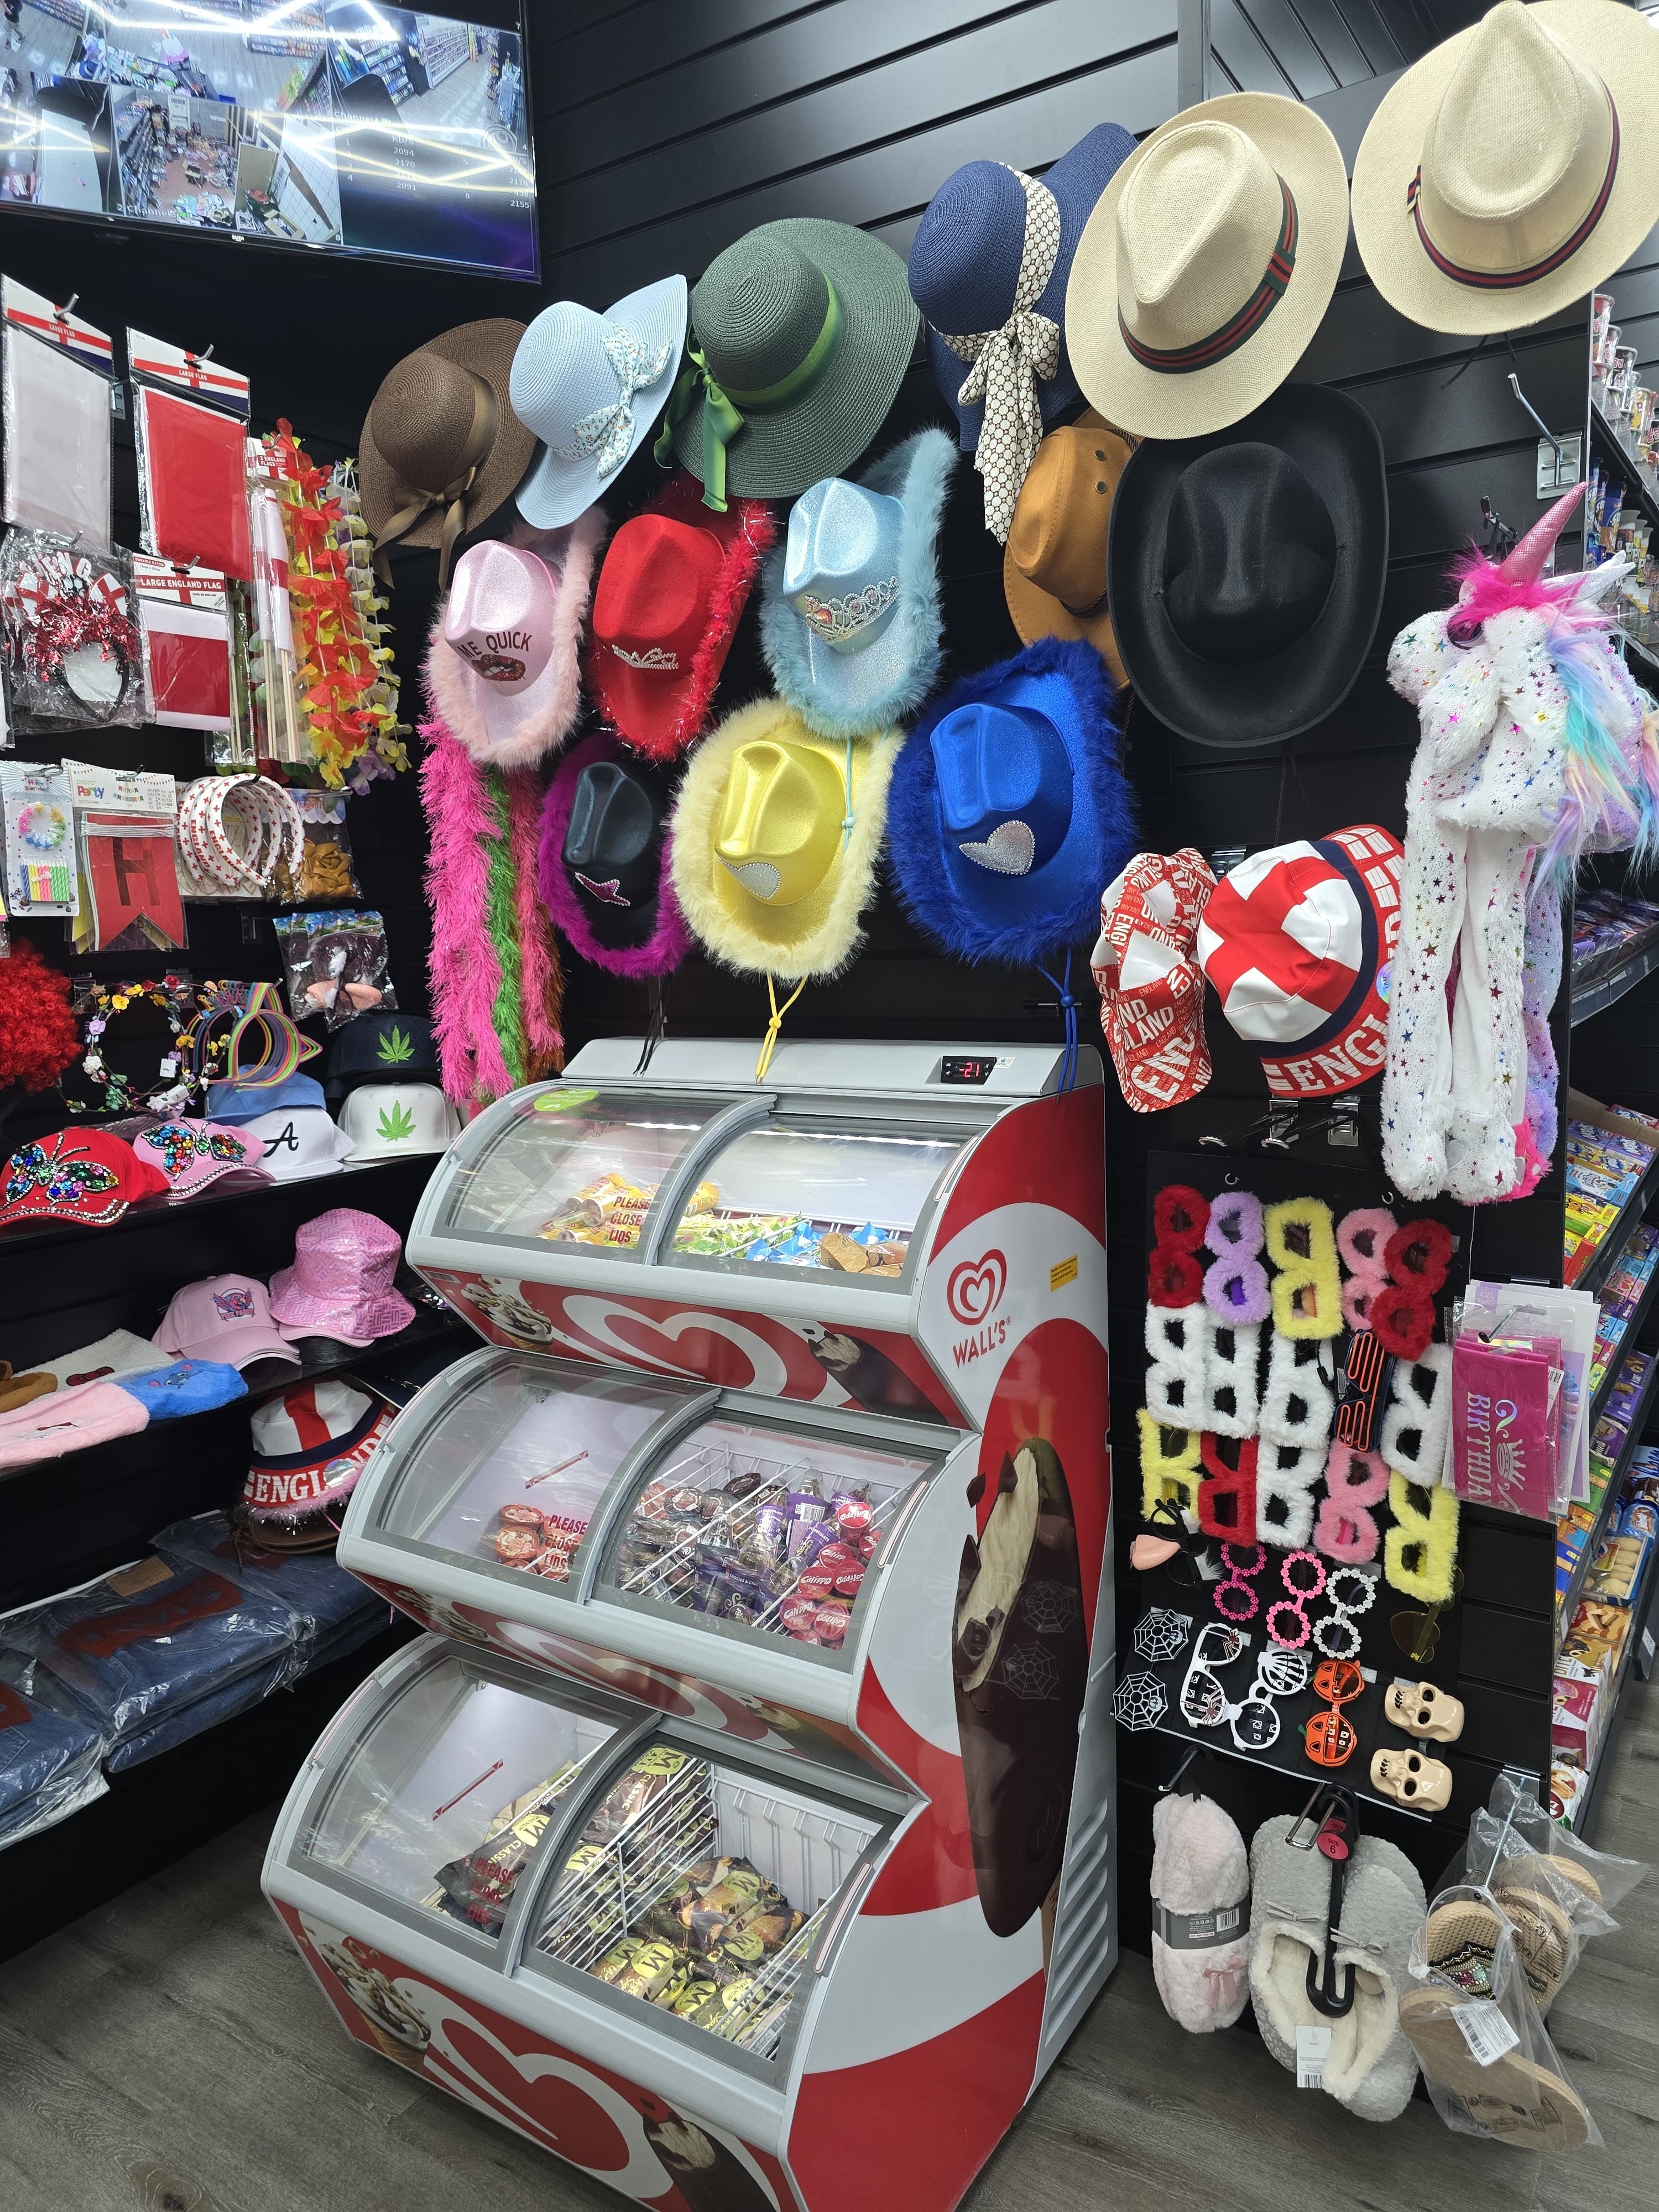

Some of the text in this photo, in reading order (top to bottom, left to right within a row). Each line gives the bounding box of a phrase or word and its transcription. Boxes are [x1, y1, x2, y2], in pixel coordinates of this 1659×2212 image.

[393, 148, 415, 156] 2094
[396, 182, 418, 191] 2091
[509, 200, 530, 208] 2155
[64, 328, 76, 338] FLAG
[178, 368, 208, 382] LARGE FLAG
[140, 578, 222, 589] LARGE ENGLAND FLAG
[456, 631, 533, 659] ME QUICK
[76, 785, 105, 800] Party
[190, 819, 211, 869] ENGLAND
[1139, 979, 1164, 997] ENGLAND
[1155, 1026, 1177, 1048] ENGLAND
[958, 1062, 980, 1078] -21
[263, 1121, 299, 1159] A
[613, 1196, 652, 1210] PLEASE
[610, 1213, 643, 1227] CLOSE
[608, 1229, 632, 1243] LIDS
[952, 1321, 1006, 1370] WALL'S
[548, 1514, 588, 1535] PLEASE
[545, 1533, 579, 1553] CLOSE
[622, 1774, 652, 1811] CLASSIC
[1328, 1838, 1340, 1847] SIZE
[1330, 1845, 1336, 1854] 6
